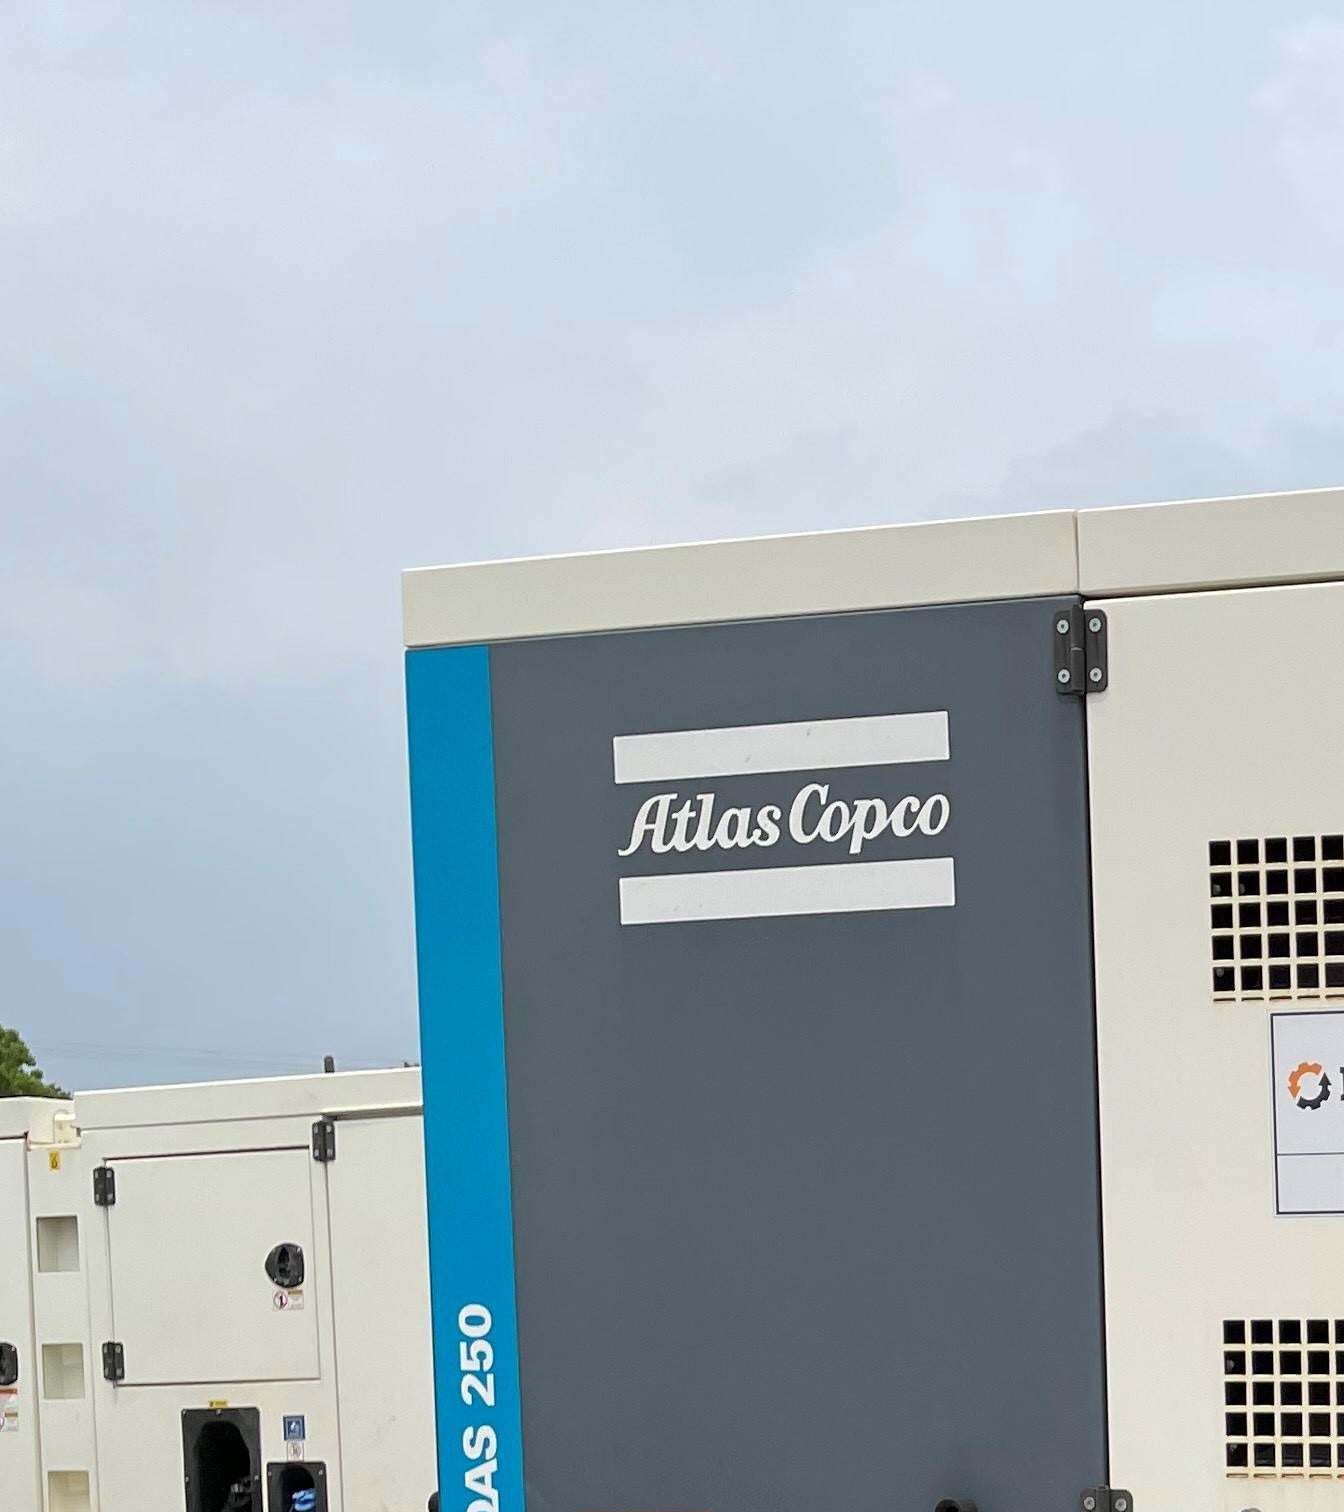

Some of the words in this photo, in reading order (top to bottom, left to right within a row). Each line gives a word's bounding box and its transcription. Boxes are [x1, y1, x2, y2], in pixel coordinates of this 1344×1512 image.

[618, 792, 781, 856] Atlas
[788, 783, 951, 855] Copco
[458, 1303, 496, 1407] 250
